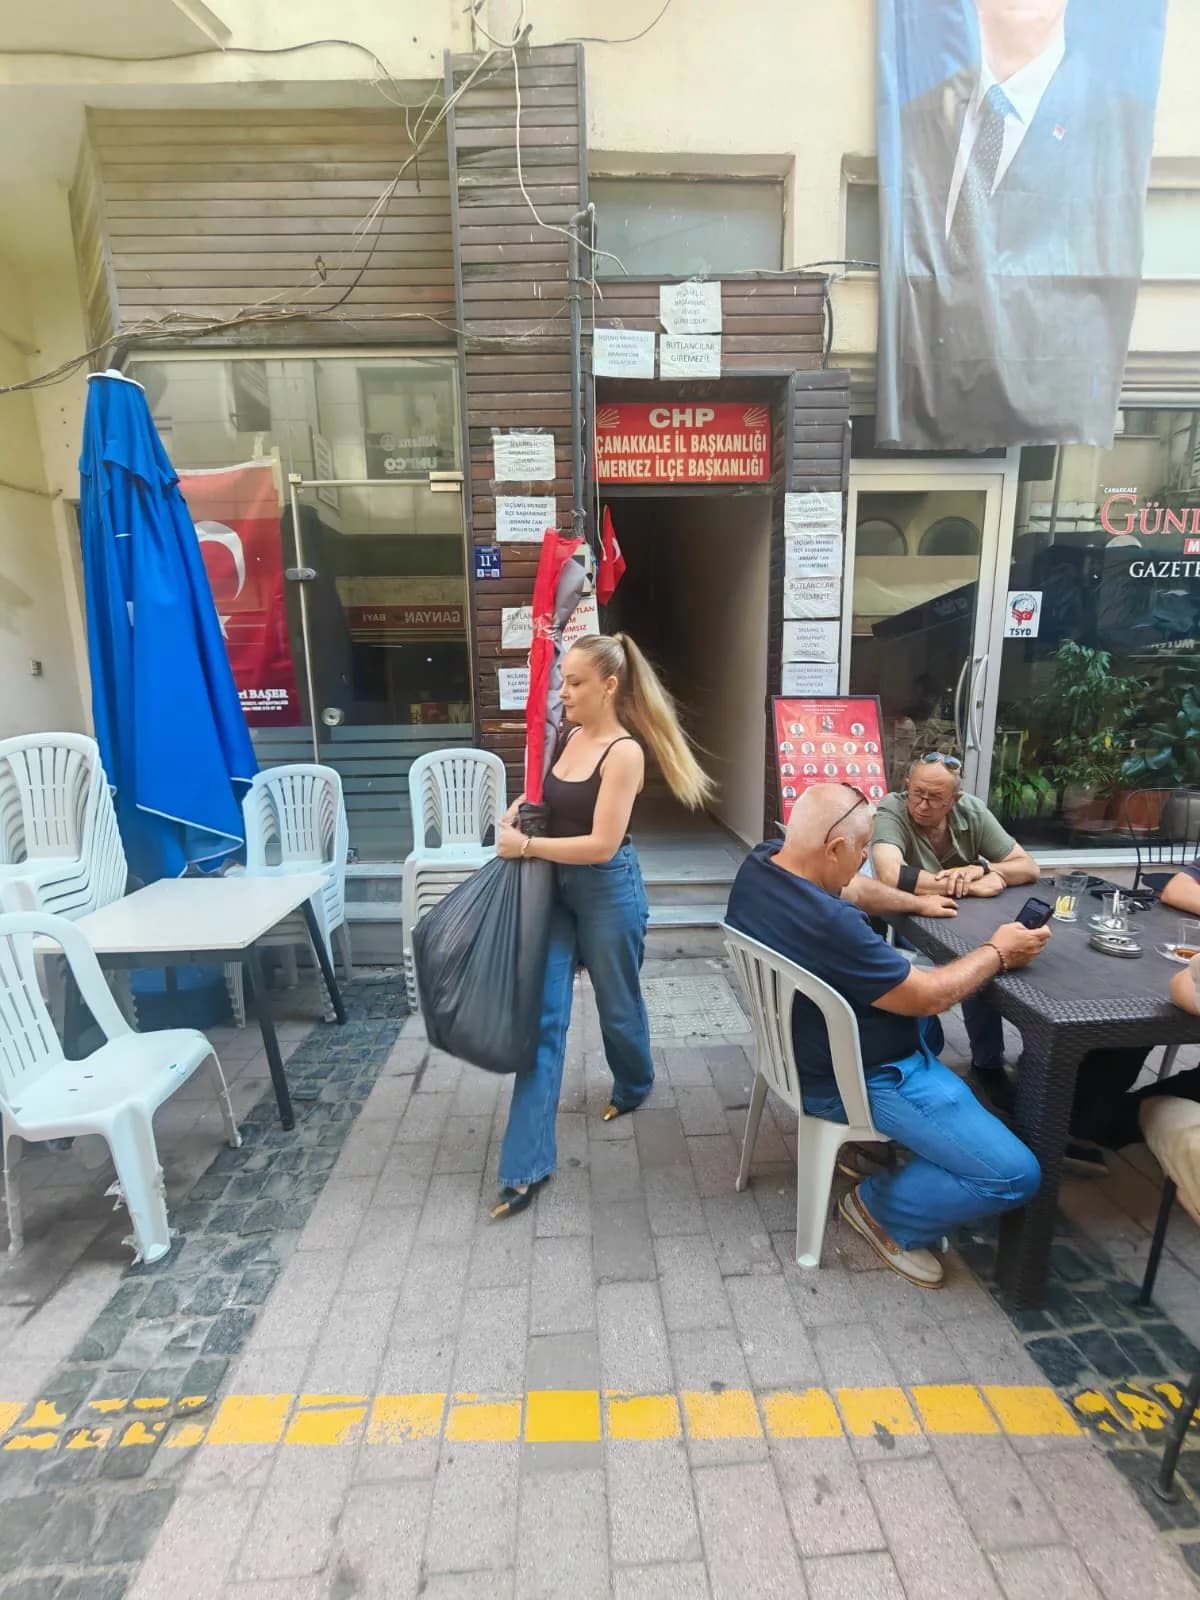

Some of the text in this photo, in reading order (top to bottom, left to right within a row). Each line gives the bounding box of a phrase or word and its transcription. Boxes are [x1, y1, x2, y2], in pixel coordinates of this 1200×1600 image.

[649, 408, 715, 428] CHP
[596, 430, 767, 458] ÇANAKKALE İL BAŞKANLIĞI
[598, 455, 764, 481] MERKEZ İLÇE BAŞKANLIĞI
[480, 555, 491, 567] 11
[1009, 627, 1032, 636] TSYD
[248, 689, 289, 701] BAŞER
